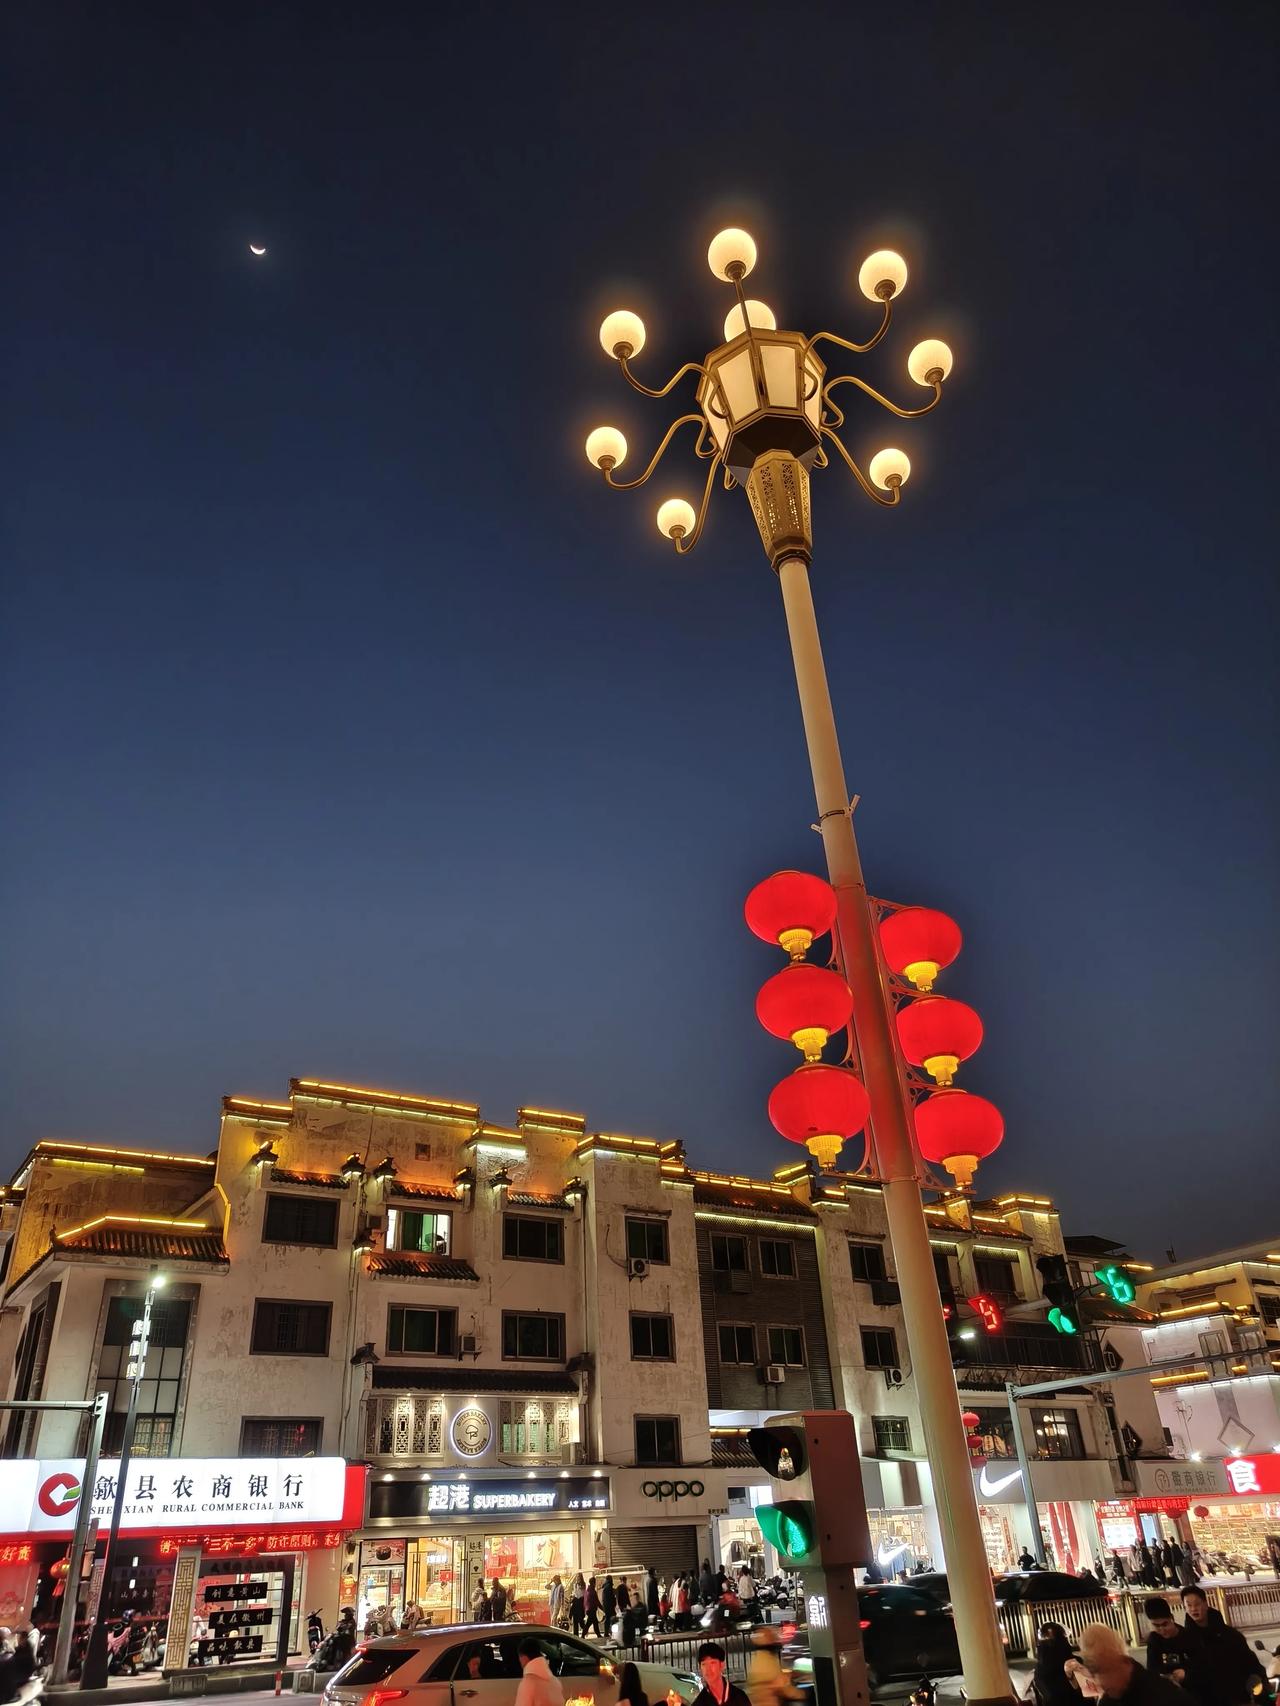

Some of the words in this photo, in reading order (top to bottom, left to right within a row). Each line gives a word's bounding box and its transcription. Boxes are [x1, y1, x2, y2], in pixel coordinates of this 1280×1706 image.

[1106, 1267, 1133, 1303] 6
[93, 1474, 304, 1500] 歙县农商银行
[1226, 1460, 1261, 1493] 食
[162, 1503, 197, 1513] RURAL
[201, 1502, 275, 1512] COMMERCIAL
[278, 1501, 304, 1510] BANK
[428, 1484, 471, 1510] 超港
